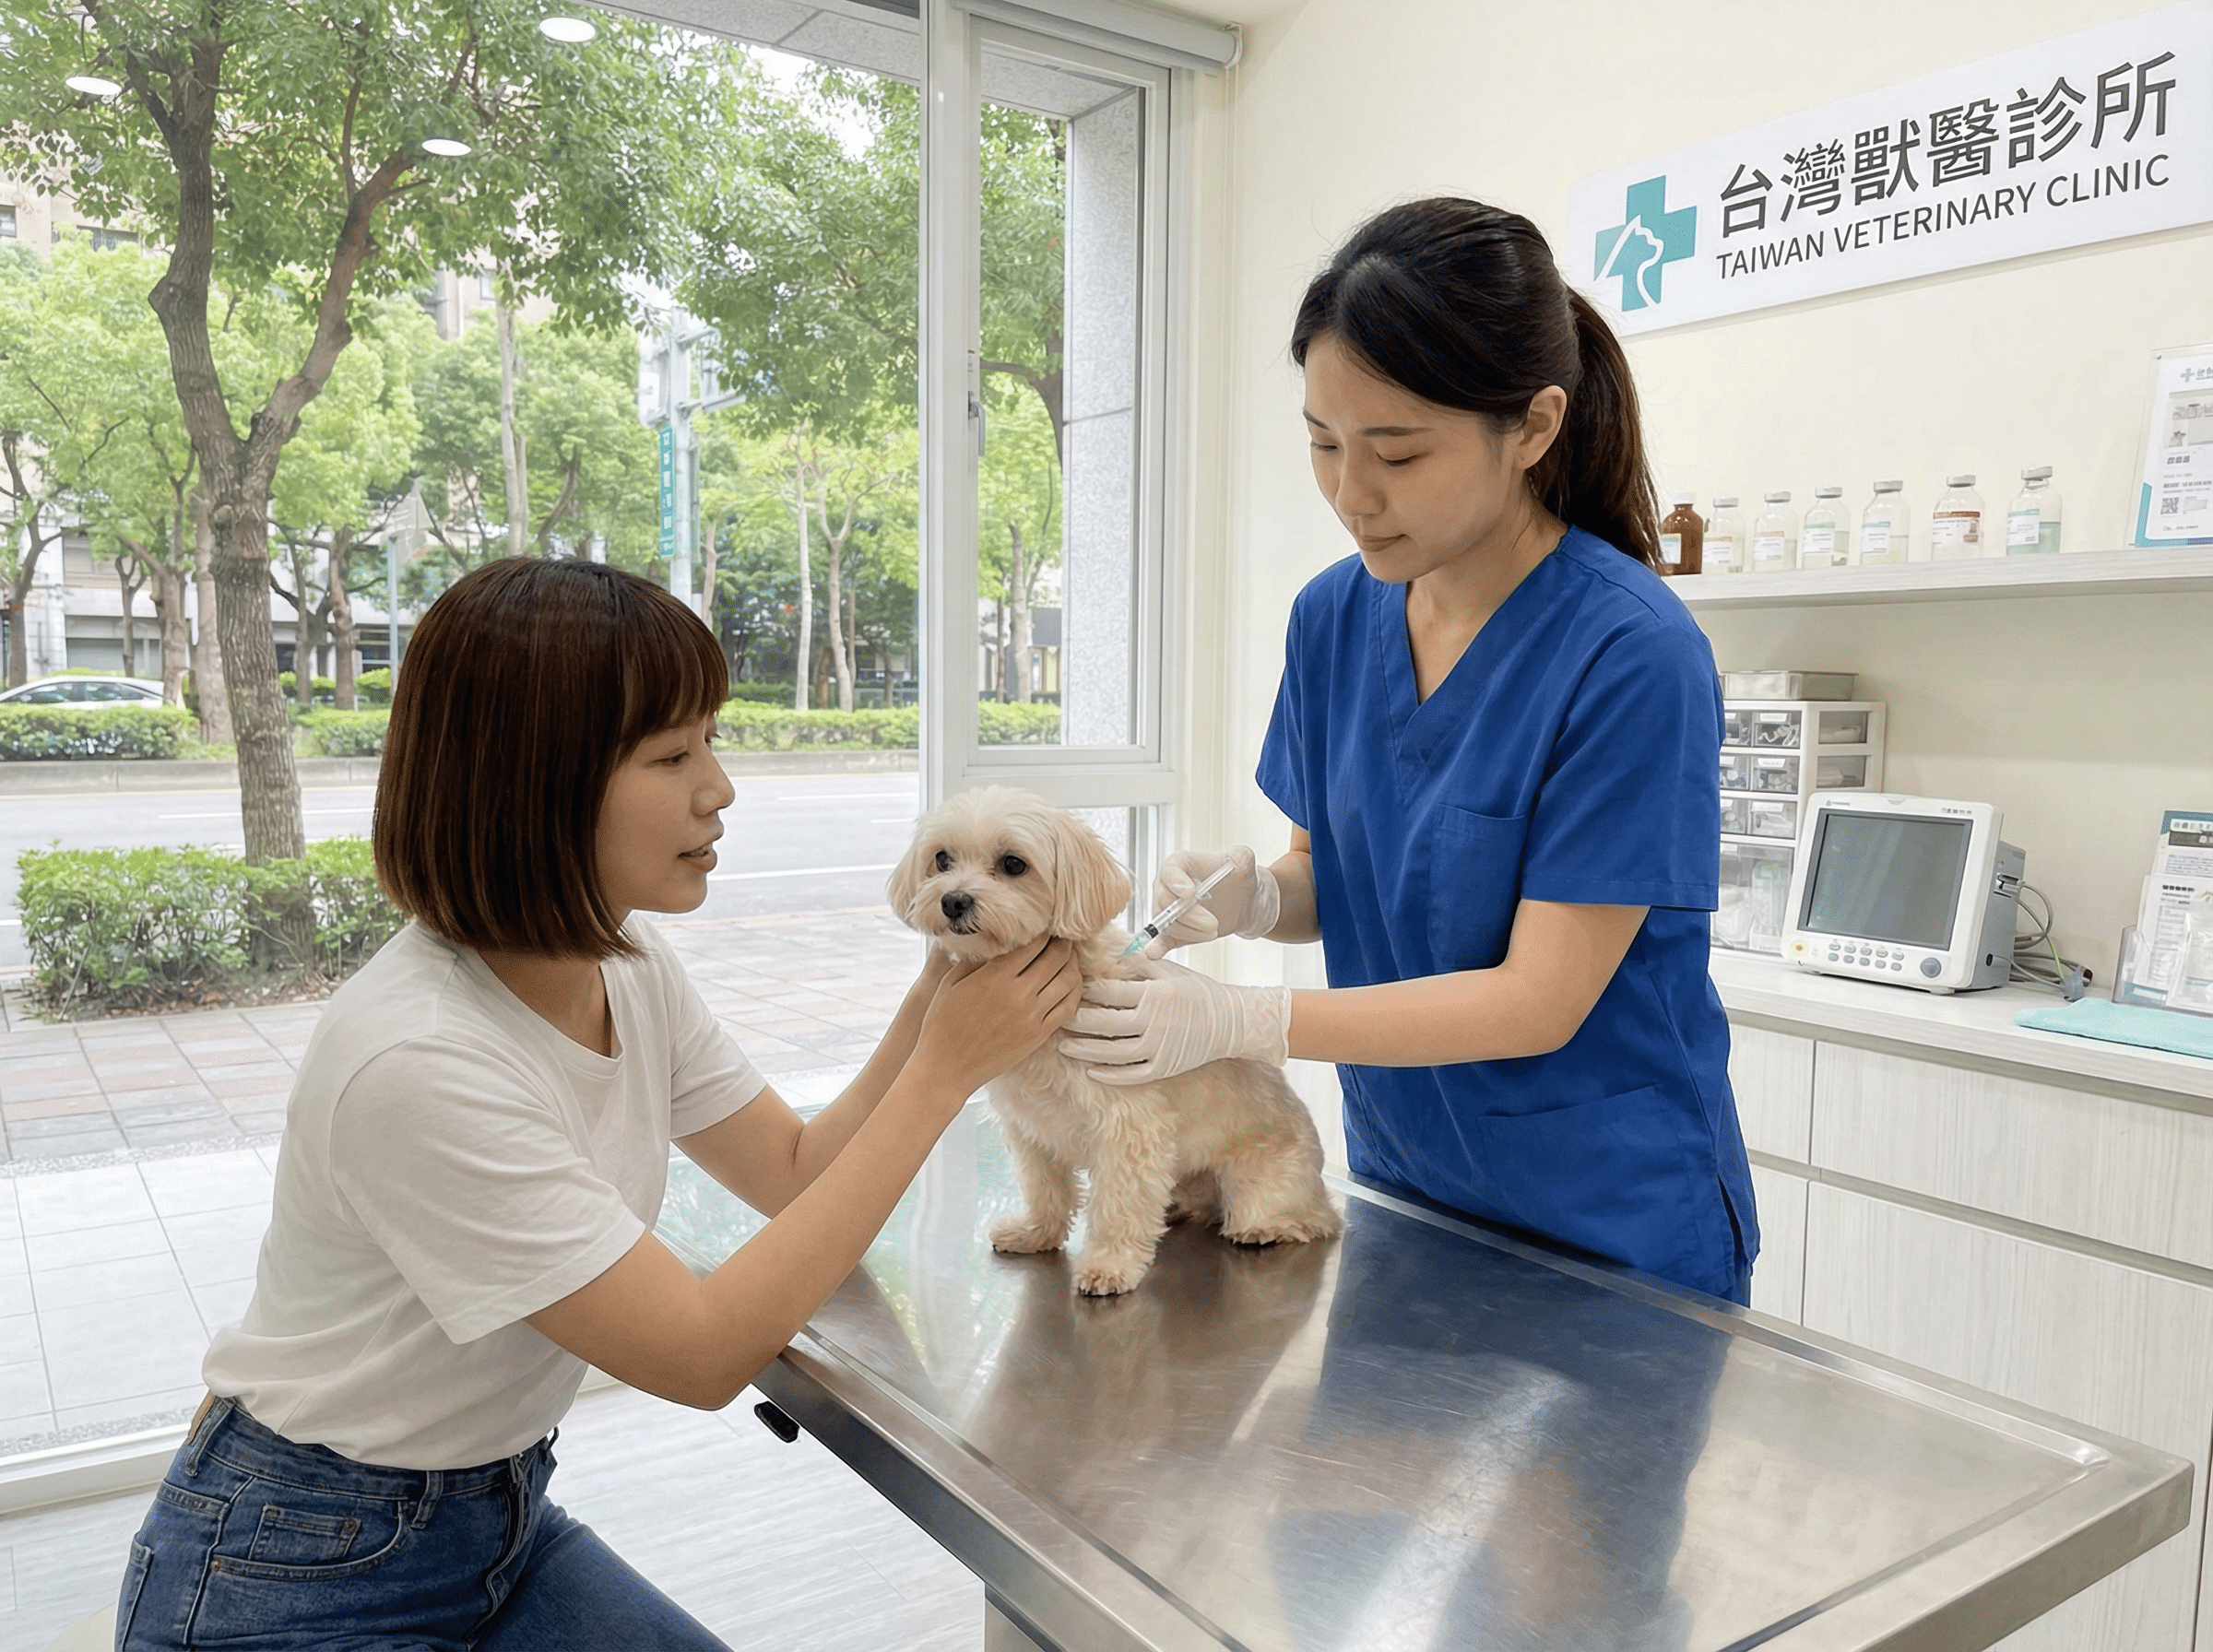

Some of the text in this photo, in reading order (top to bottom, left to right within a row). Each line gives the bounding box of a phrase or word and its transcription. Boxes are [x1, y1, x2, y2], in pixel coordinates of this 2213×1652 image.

[1716, 154, 2170, 279] TAIWAN VETERINARY CLINIC
[1720, 51, 2176, 239] 台灣獸醫診所
